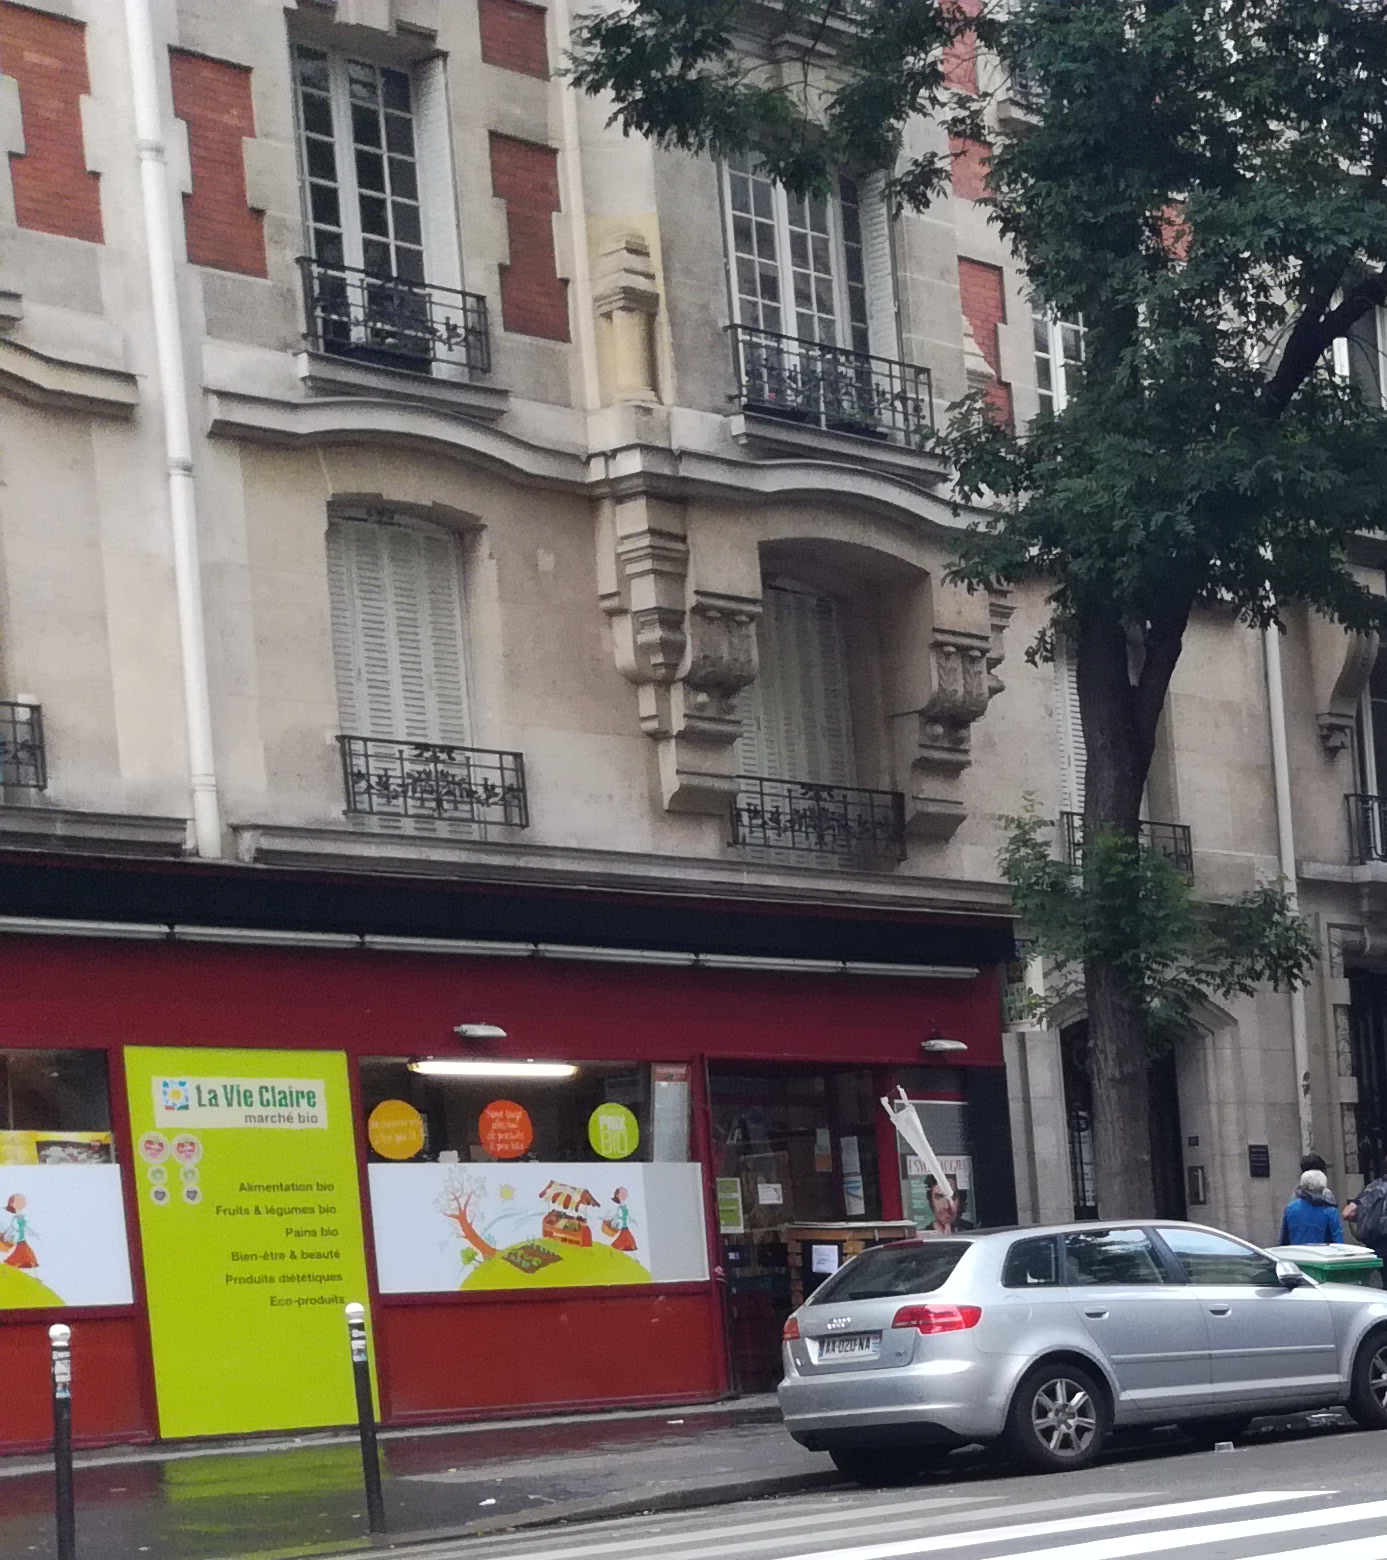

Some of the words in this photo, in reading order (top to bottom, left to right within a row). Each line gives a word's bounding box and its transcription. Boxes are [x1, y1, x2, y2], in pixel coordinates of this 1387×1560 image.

[195, 1084, 220, 1108] La
[222, 1084, 254, 1107] Vie
[258, 1085, 317, 1109] Claire
[244, 1112, 294, 1124] marché
[297, 1111, 319, 1124] bio
[239, 1182, 313, 1192] Alimentation
[316, 1181, 335, 1192] bio
[215, 1205, 250, 1216] Fruits
[253, 1205, 262, 1215] &
[265, 1205, 315, 1217] légumes
[318, 1204, 337, 1214] bio
[285, 1227, 318, 1238] Pains
[320, 1226, 339, 1237] bio
[231, 1251, 286, 1261] Bien-être
[289, 1250, 298, 1260] &
[300, 1249, 341, 1260] beauté
[225, 1274, 276, 1285] Produits
[278, 1273, 343, 1284] diététiques
[269, 1295, 346, 1308] Eco-produits
